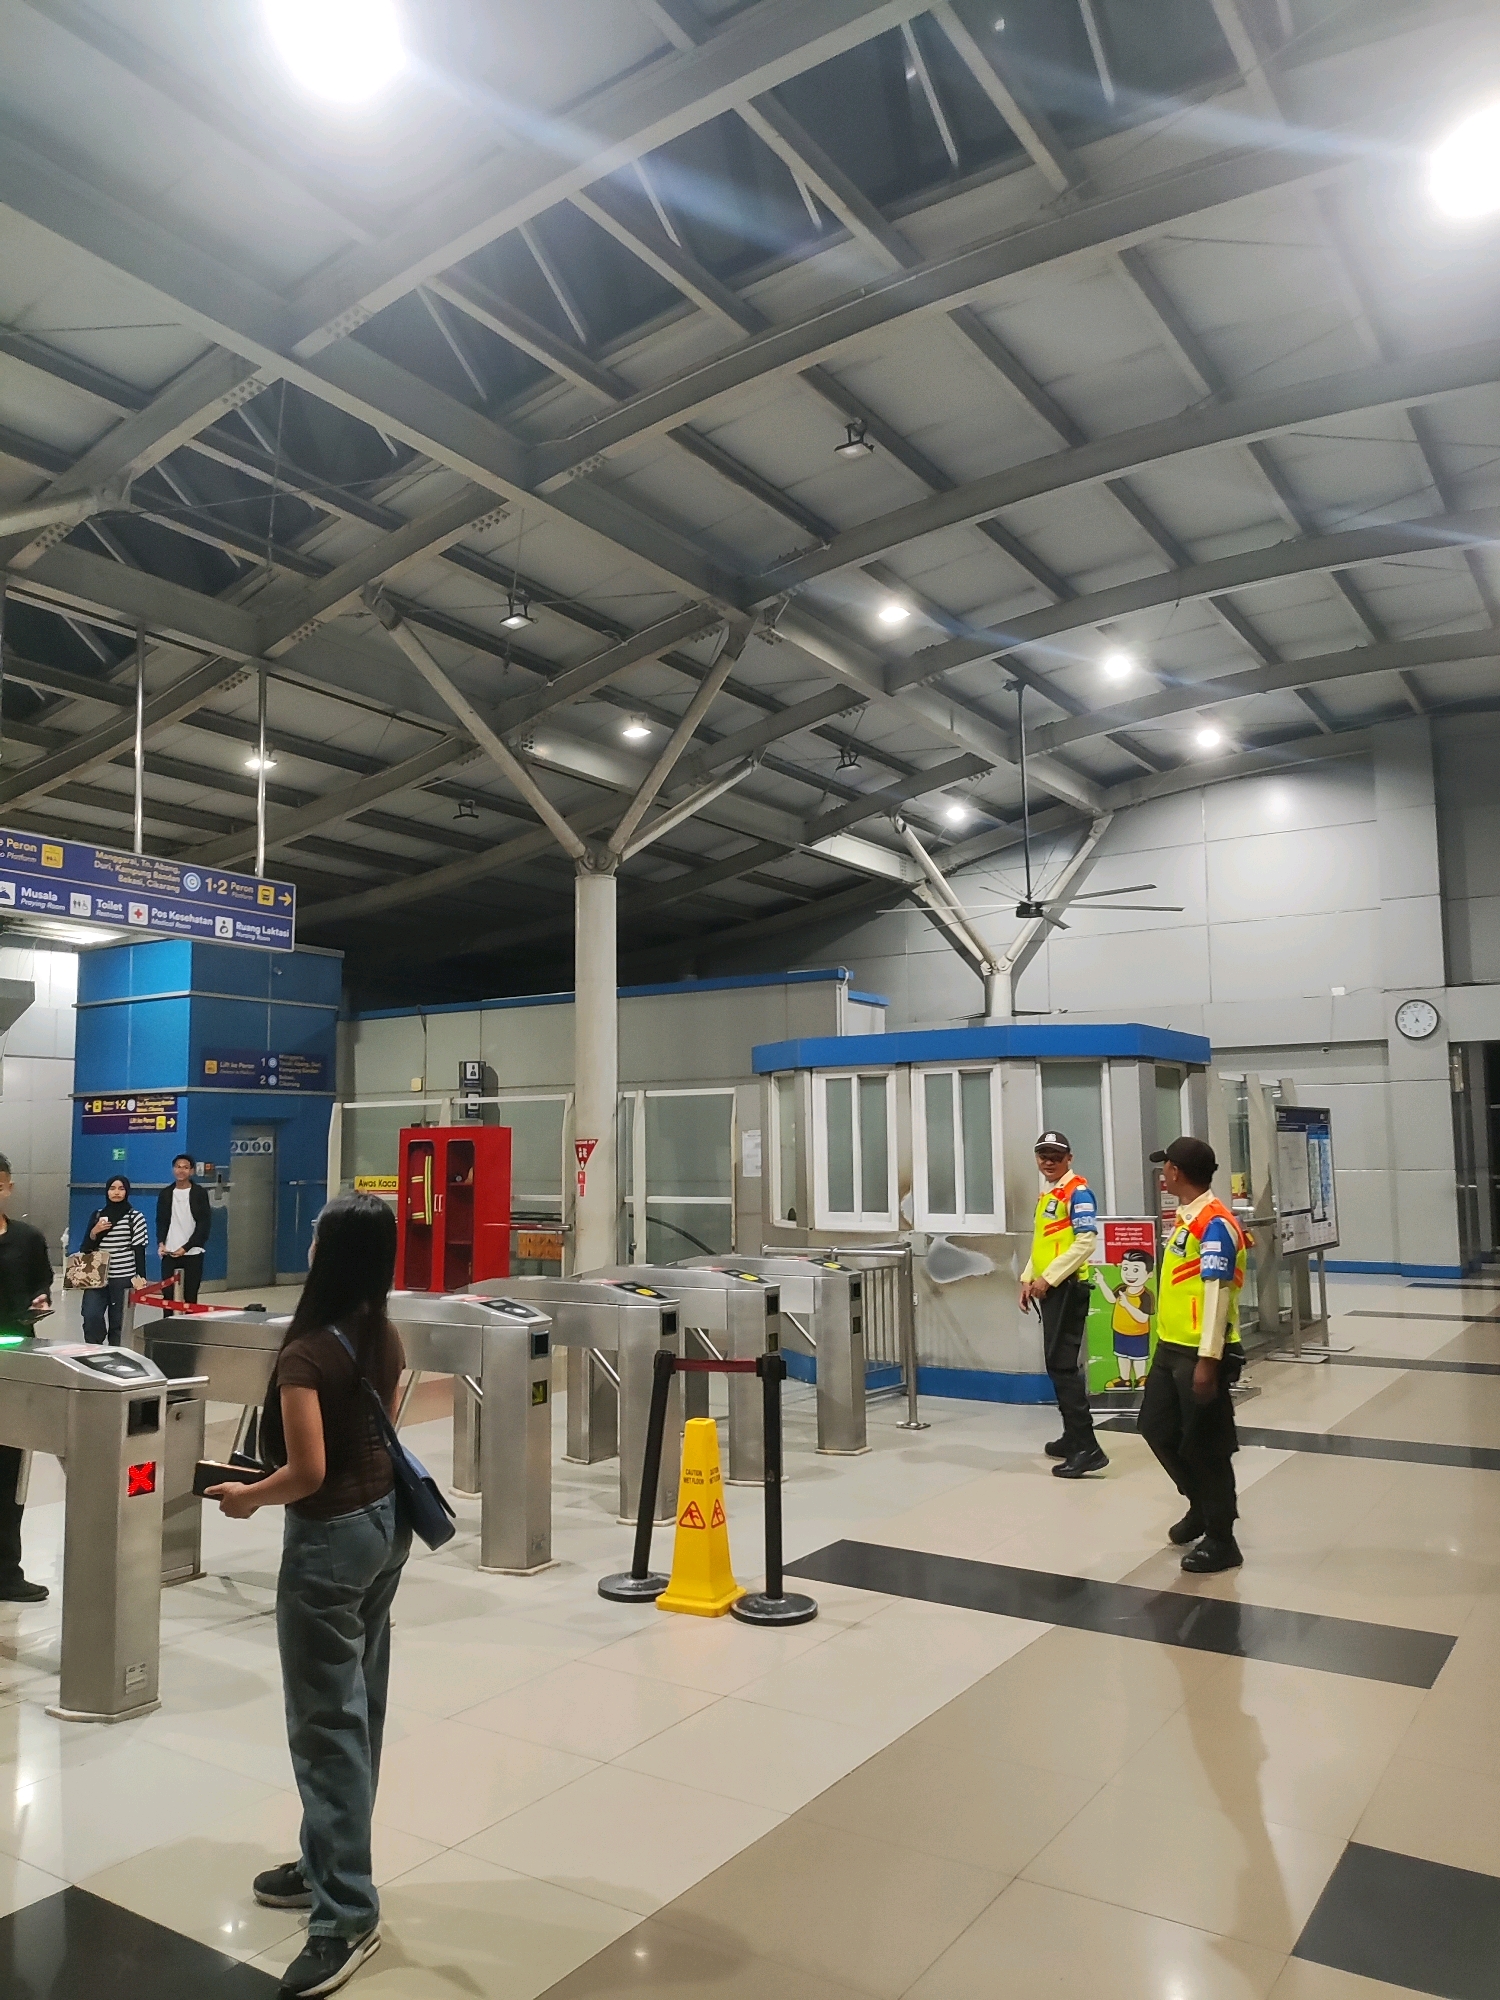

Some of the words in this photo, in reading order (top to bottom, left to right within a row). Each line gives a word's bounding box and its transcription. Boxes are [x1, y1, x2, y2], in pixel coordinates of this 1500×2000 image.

[6, 838, 37, 852] Peron
[21, 886, 58, 902] Musala
[230, 882, 254, 894] Peron
[96, 898, 123, 912] Toilet
[152, 908, 168, 918] Pos
[168, 910, 214, 926] Kesehatan
[236, 921, 260, 935] Ruang
[260, 1075, 266, 1084] 2
[358, 1178, 376, 1188] Awas
[378, 1178, 397, 1188] Kaca
[685, 1468, 702, 1476] CAUTION
[692, 1477, 704, 1485] FLOOR
